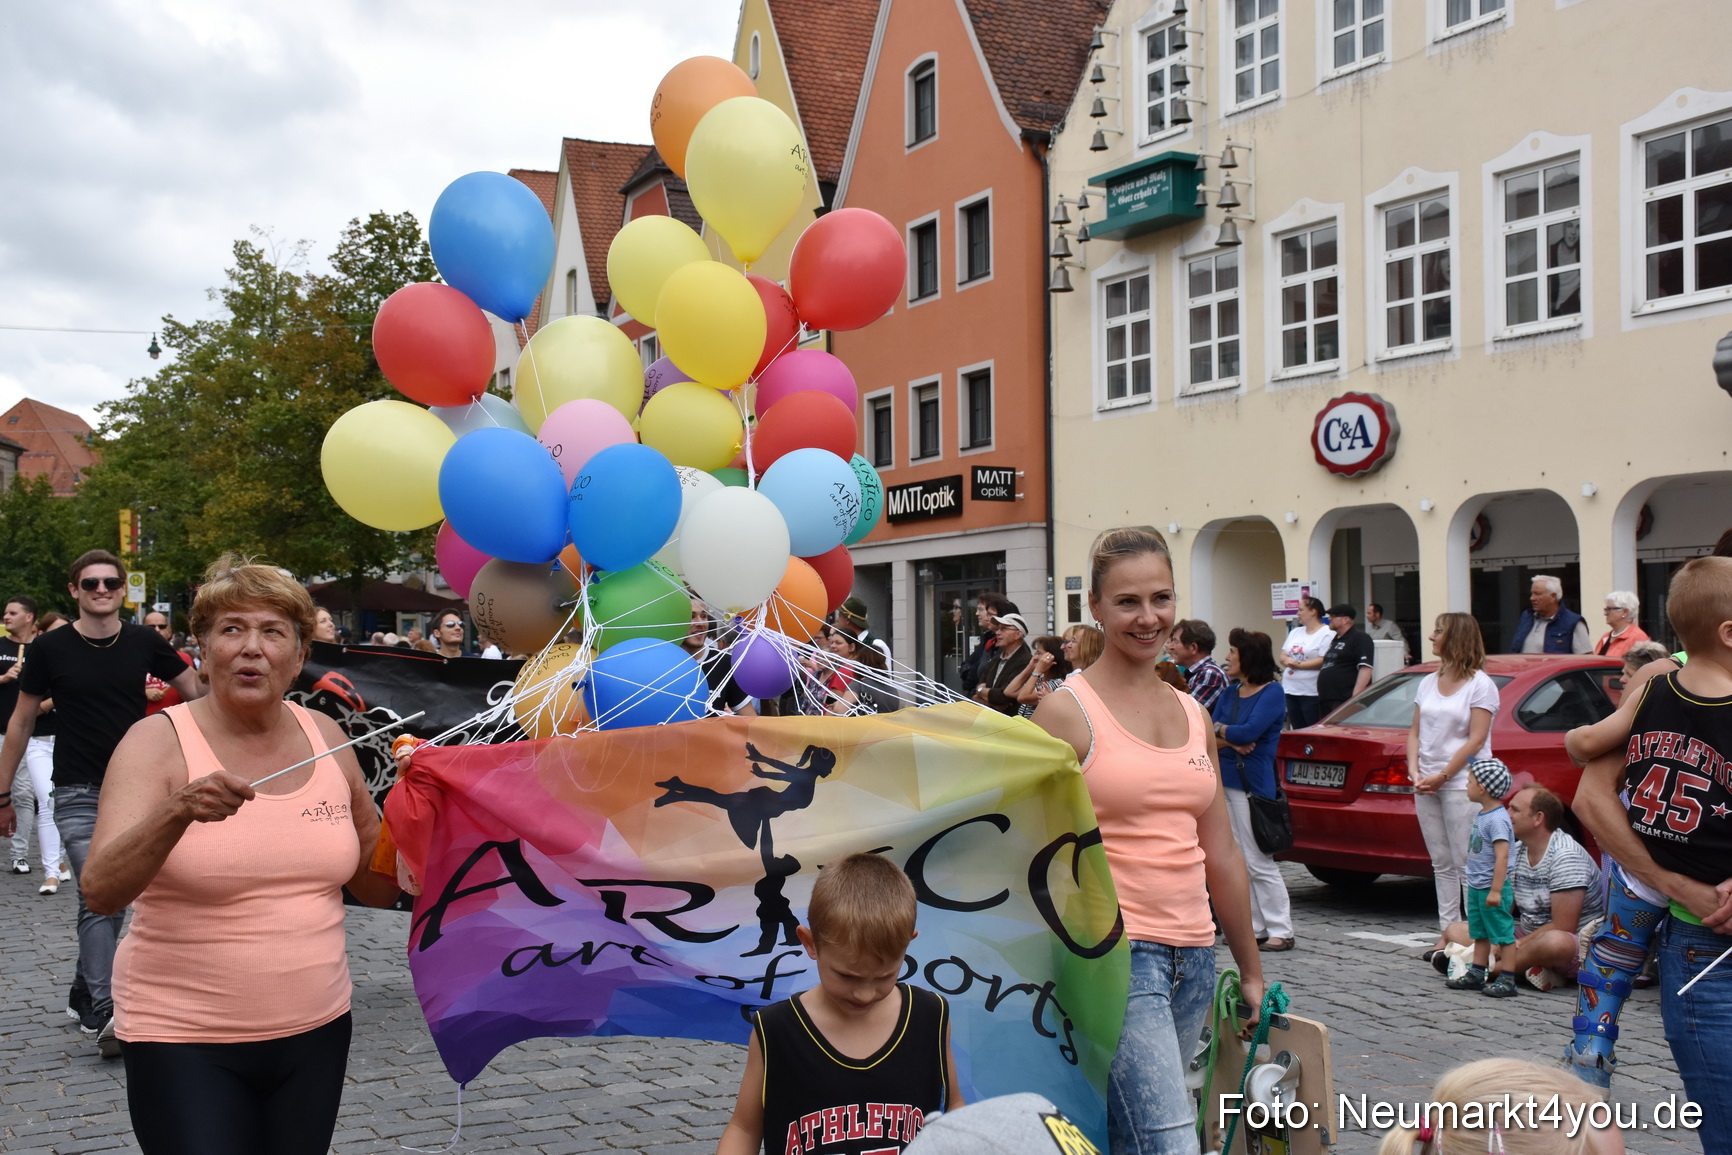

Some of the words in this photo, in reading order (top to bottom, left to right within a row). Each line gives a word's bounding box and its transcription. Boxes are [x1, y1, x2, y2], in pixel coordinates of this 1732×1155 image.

[1323, 414, 1374, 452] C&A
[977, 469, 1014, 485] MATT
[980, 487, 1008, 498] optik
[1631, 763, 1703, 834] 45
[695, 949, 807, 1000] of
